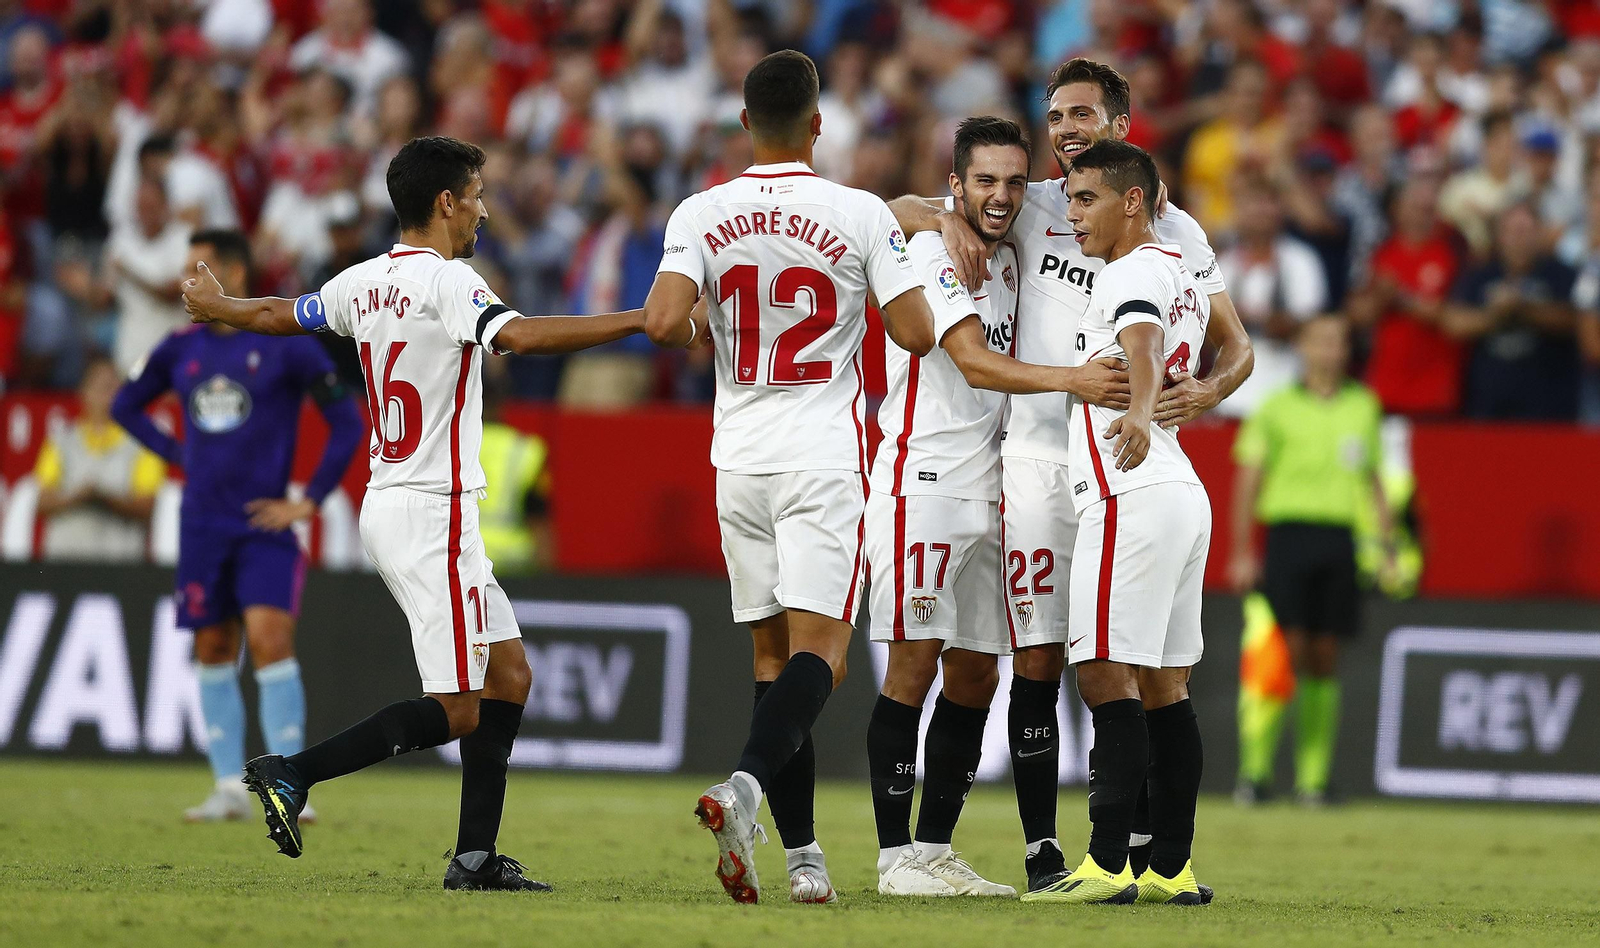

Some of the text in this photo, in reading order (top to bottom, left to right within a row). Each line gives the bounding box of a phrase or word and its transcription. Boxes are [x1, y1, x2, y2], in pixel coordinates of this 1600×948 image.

[703, 207, 849, 267] ANDRÉ SILVA
[303, 294, 322, 319] C
[714, 264, 838, 386] 12
[359, 341, 423, 463] 16
[906, 541, 952, 591] 17
[1007, 547, 1055, 597] 22
[465, 586, 489, 635] 1
[1023, 726, 1051, 740] SFC
[1437, 669, 1584, 754] REV
[895, 762, 916, 775] SFC
